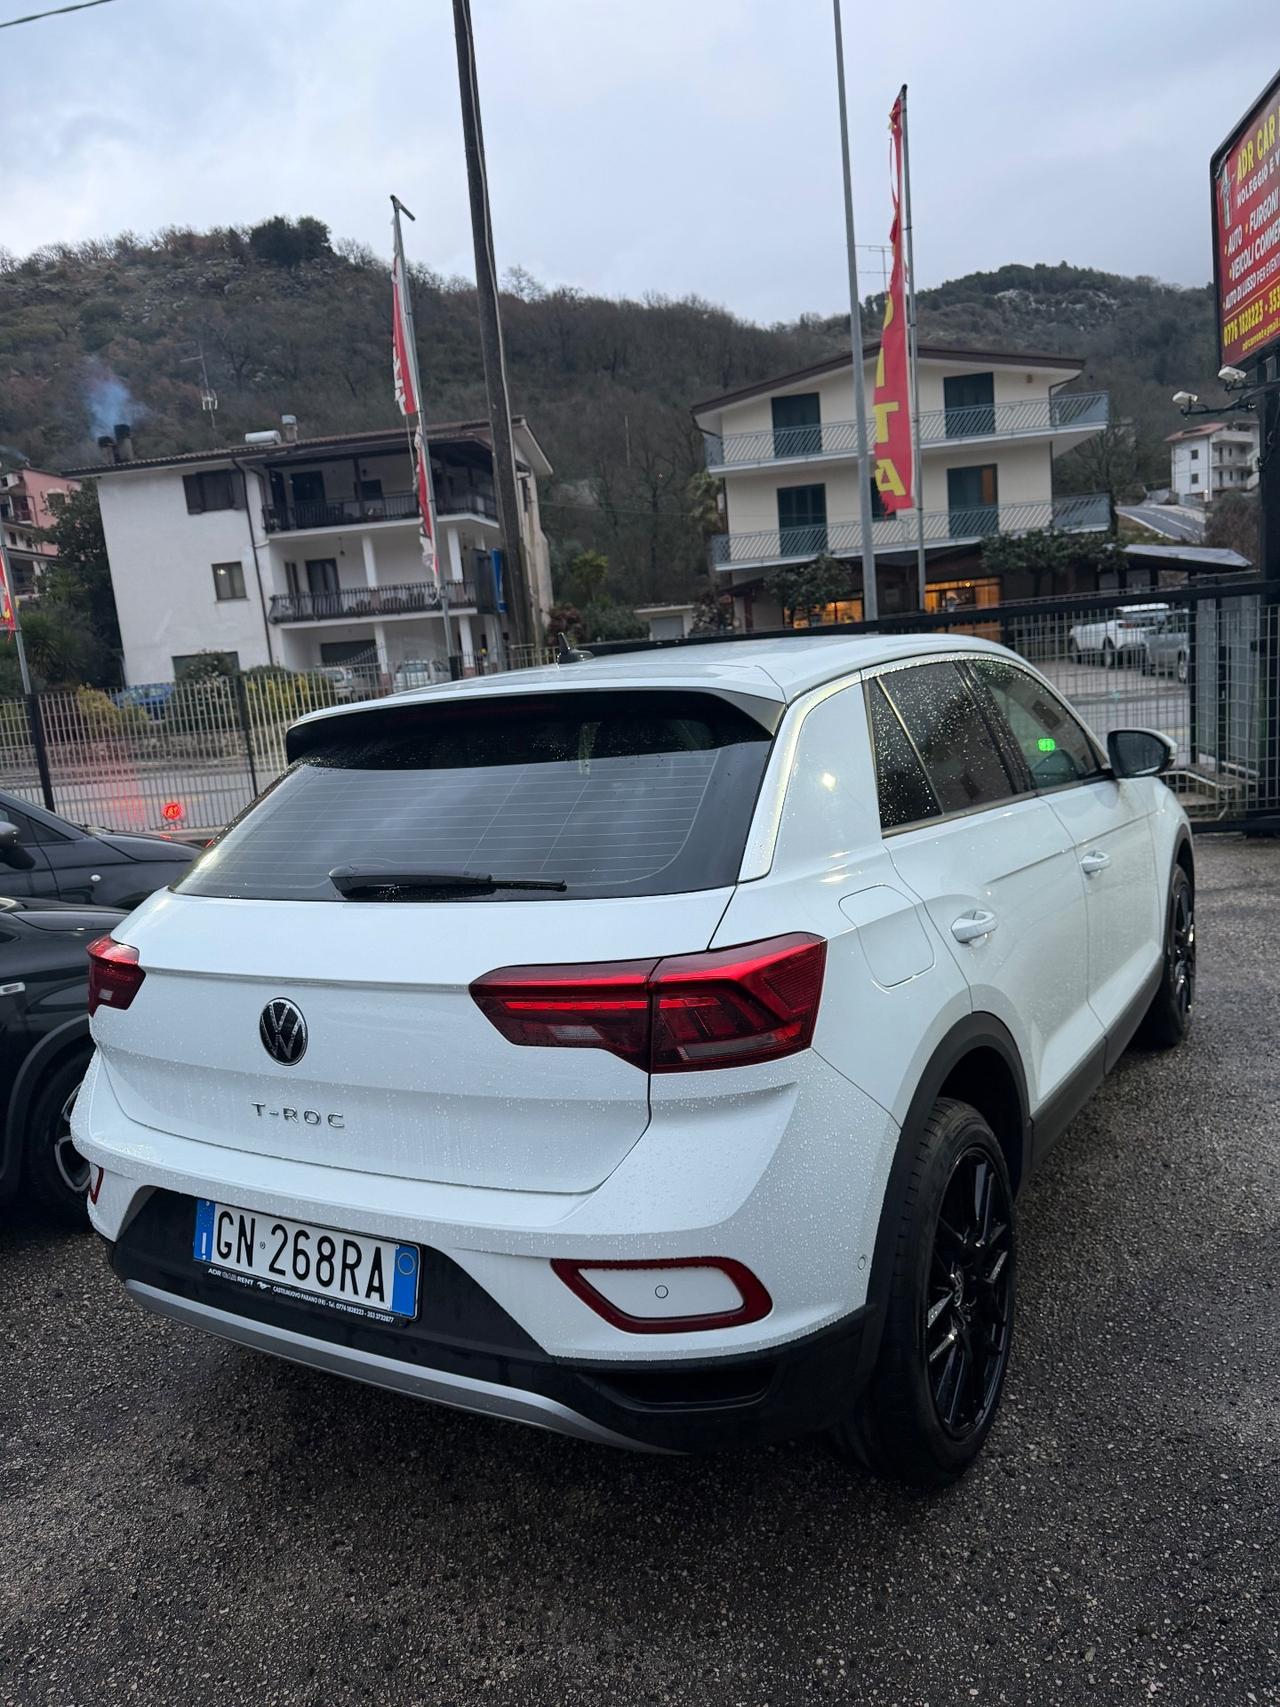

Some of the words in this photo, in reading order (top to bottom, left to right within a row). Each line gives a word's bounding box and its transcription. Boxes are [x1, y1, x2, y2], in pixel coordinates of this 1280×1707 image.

[1236, 140, 1254, 185] ADR
[1257, 113, 1275, 160] CAR
[1237, 163, 1268, 208] NOLEGGIO
[1228, 224, 1242, 256] AUTO
[1250, 186, 1278, 235] FURGONI
[1231, 242, 1254, 281] VEICOLI
[251, 1101, 345, 1128] T-ROC
[208, 1268, 222, 1276] ADR
[237, 1275, 254, 1286] RENT
[216, 1210, 256, 1268] GN
[268, 1223, 385, 1302] 268RA
